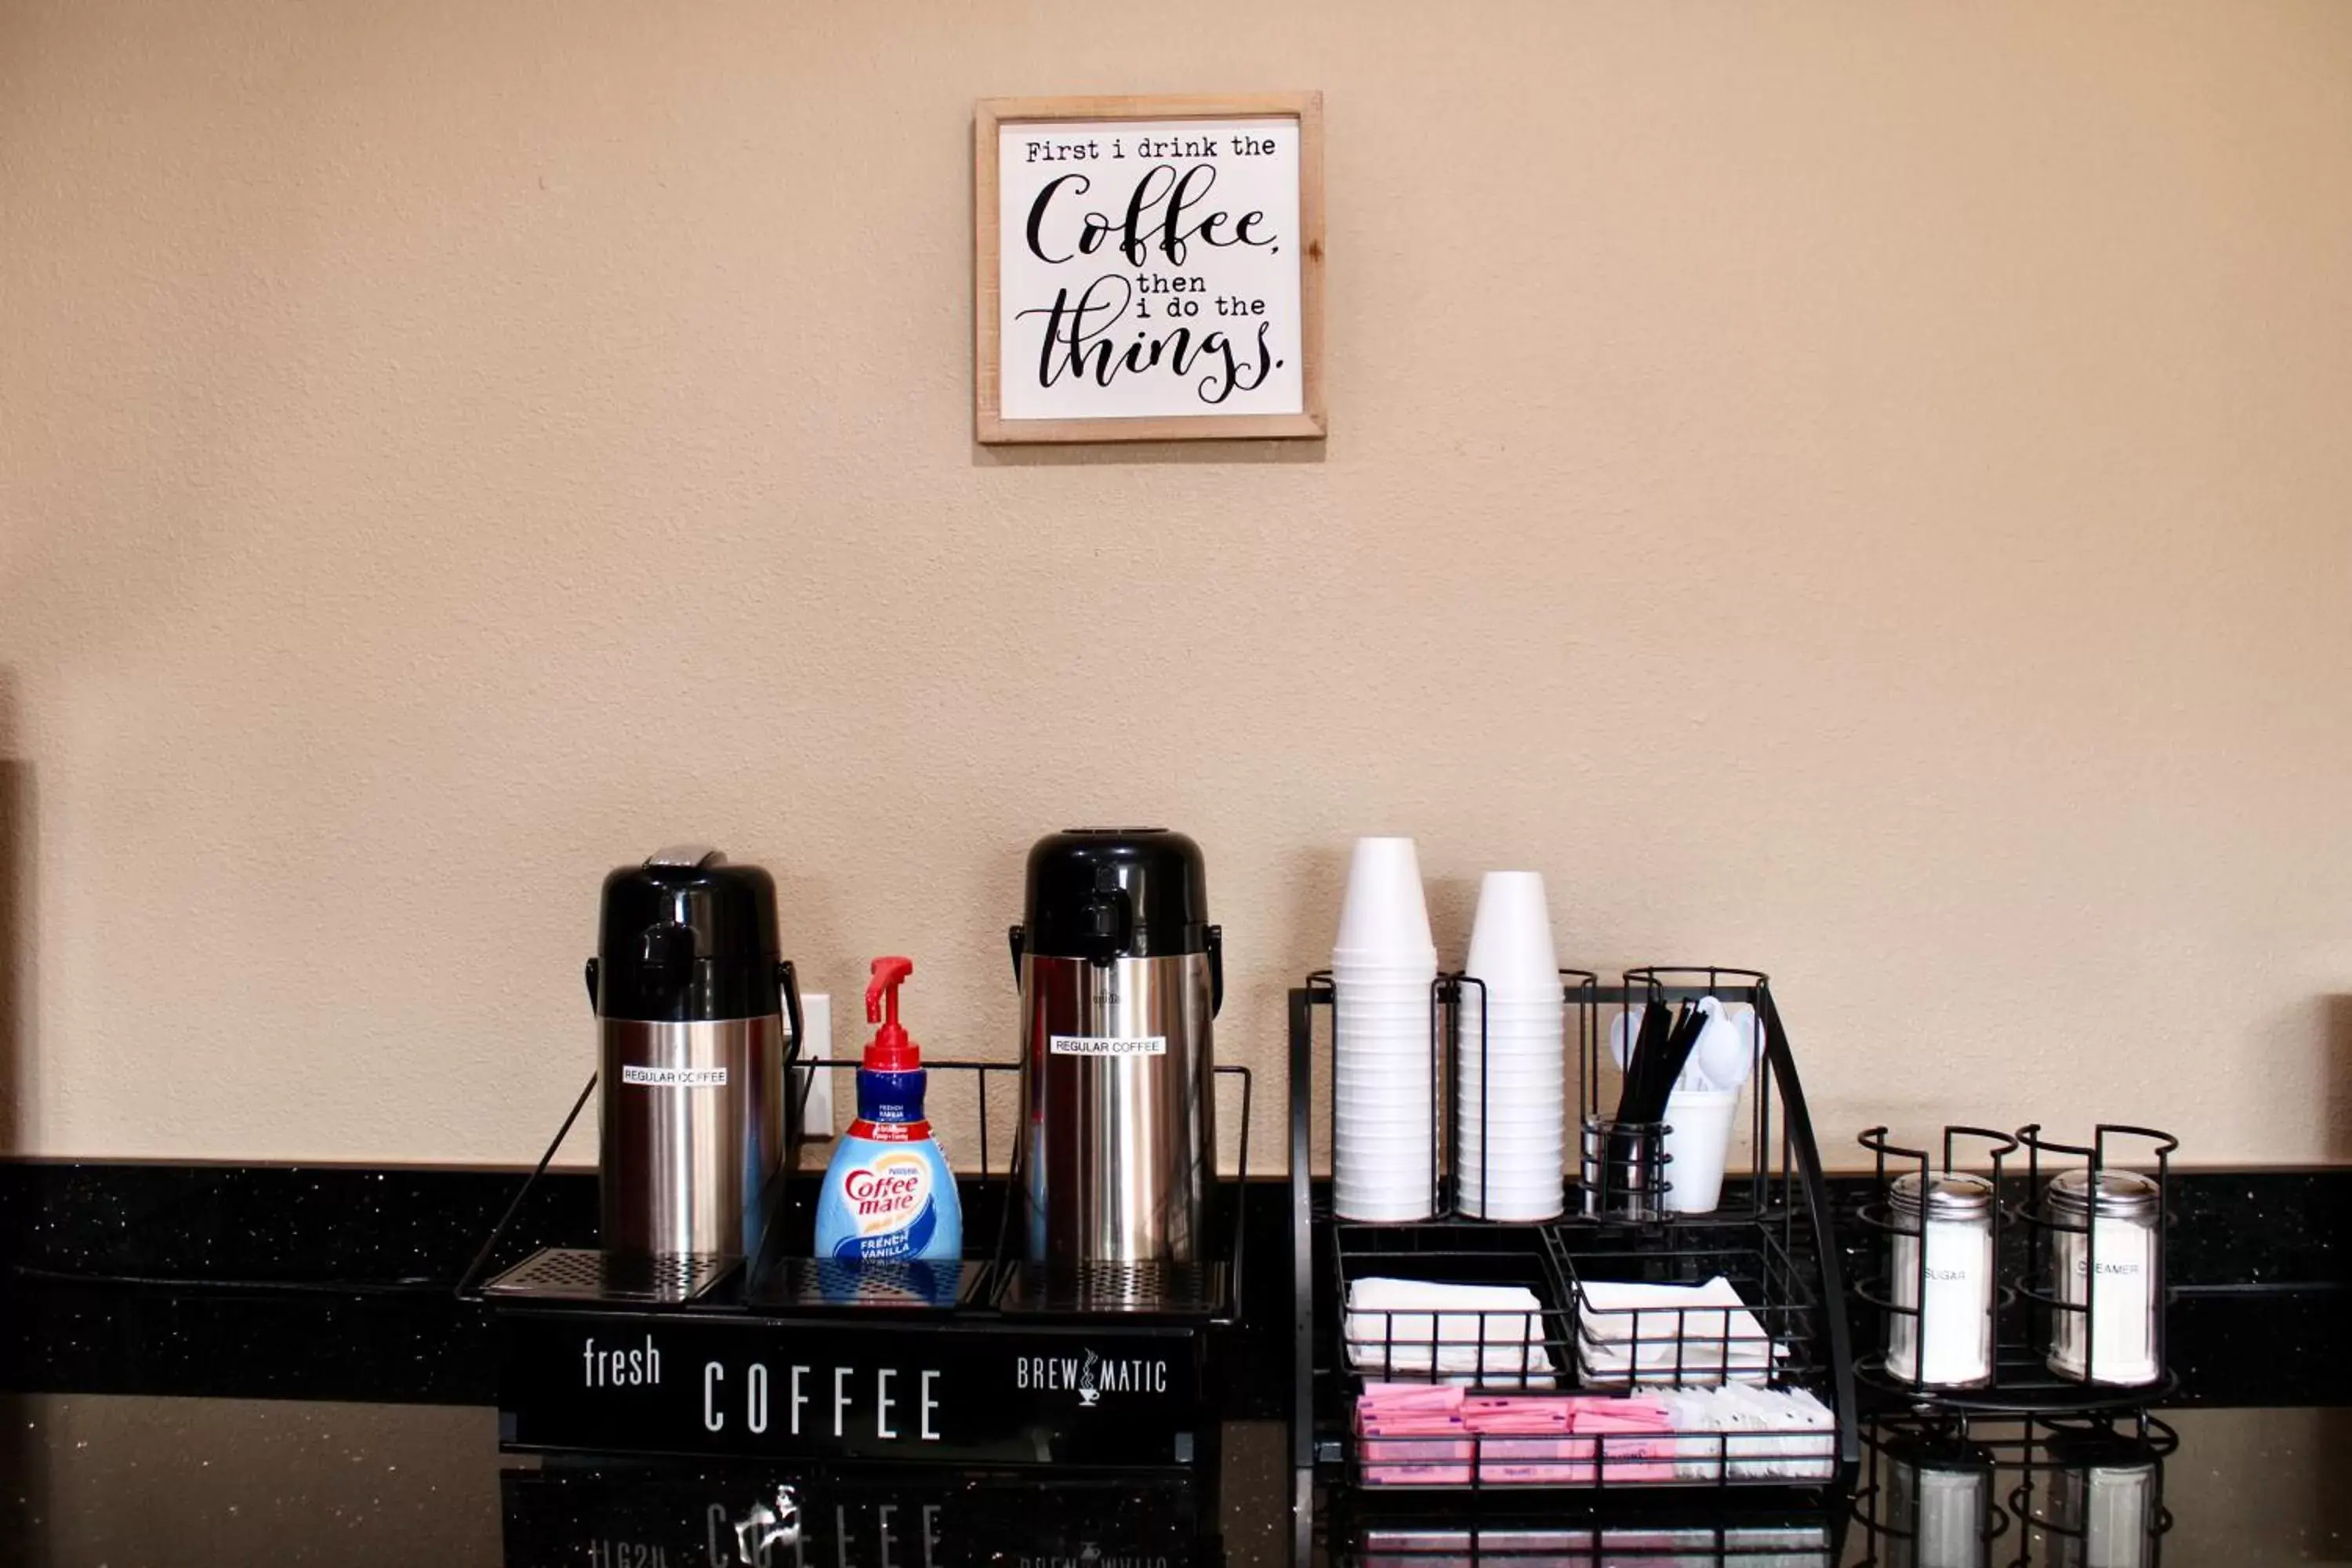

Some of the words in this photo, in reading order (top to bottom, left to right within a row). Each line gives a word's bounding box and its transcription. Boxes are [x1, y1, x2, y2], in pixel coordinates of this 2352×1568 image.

[1026, 140, 1099, 163] First
[1112, 138, 1126, 158] i
[1138, 136, 1218, 157] drink
[1231, 136, 1276, 155] the
[1025, 164, 1279, 267] Coffee,
[1136, 273, 1207, 293] then
[1136, 297, 1151, 318] i
[1166, 296, 1200, 316] do
[1215, 296, 1265, 315] the
[1014, 274, 1285, 404] things.
[1055, 1040, 1109, 1052] REGULAR
[1112, 1042, 1160, 1053] COFFEE
[625, 1069, 675, 1082] REGULAR
[678, 1072, 726, 1083] COFFEE
[845, 1169, 918, 1200] Coffee
[858, 1194, 913, 1214] mate
[860, 1229, 909, 1250] FRENCH
[862, 1243, 910, 1258] VANILLA
[1923, 1267, 1966, 1280] SUGAR
[2078, 1260, 2139, 1275] CEAMER
[1017, 1357, 1078, 1390] BREW
[1099, 1359, 1167, 1392] MATIC
[583, 1334, 660, 1387] fresh
[705, 1361, 941, 1439] COFFEE
